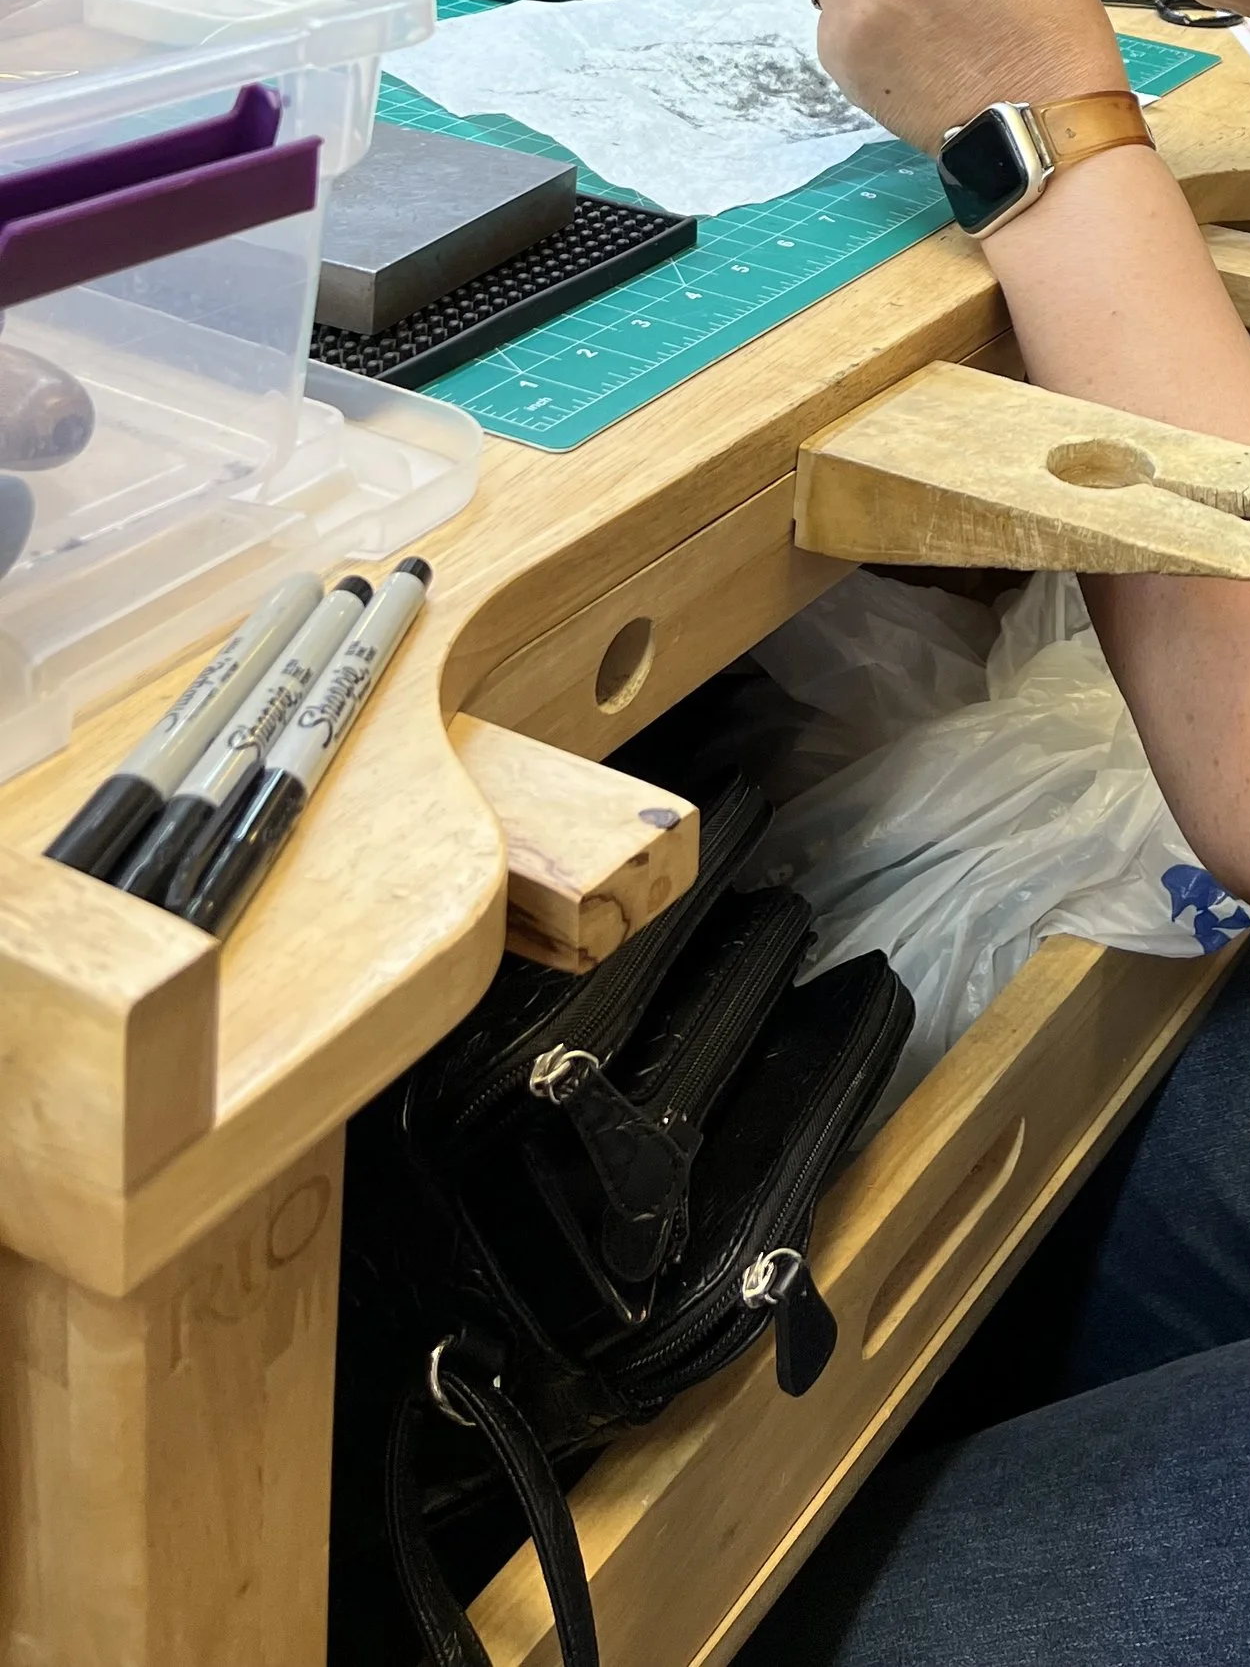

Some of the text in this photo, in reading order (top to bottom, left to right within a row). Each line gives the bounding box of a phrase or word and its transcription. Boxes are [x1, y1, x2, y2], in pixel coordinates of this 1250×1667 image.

[519, 379, 539, 389] 1
[576, 347, 599, 359] 2
[631, 319, 651, 329] 3
[684, 291, 702, 301] 4
[731, 264, 750, 273] 5
[777, 239, 795, 248] 6
[818, 214, 836, 224] 7
[860, 191, 877, 200] 8
[522, 395, 554, 413] inch
